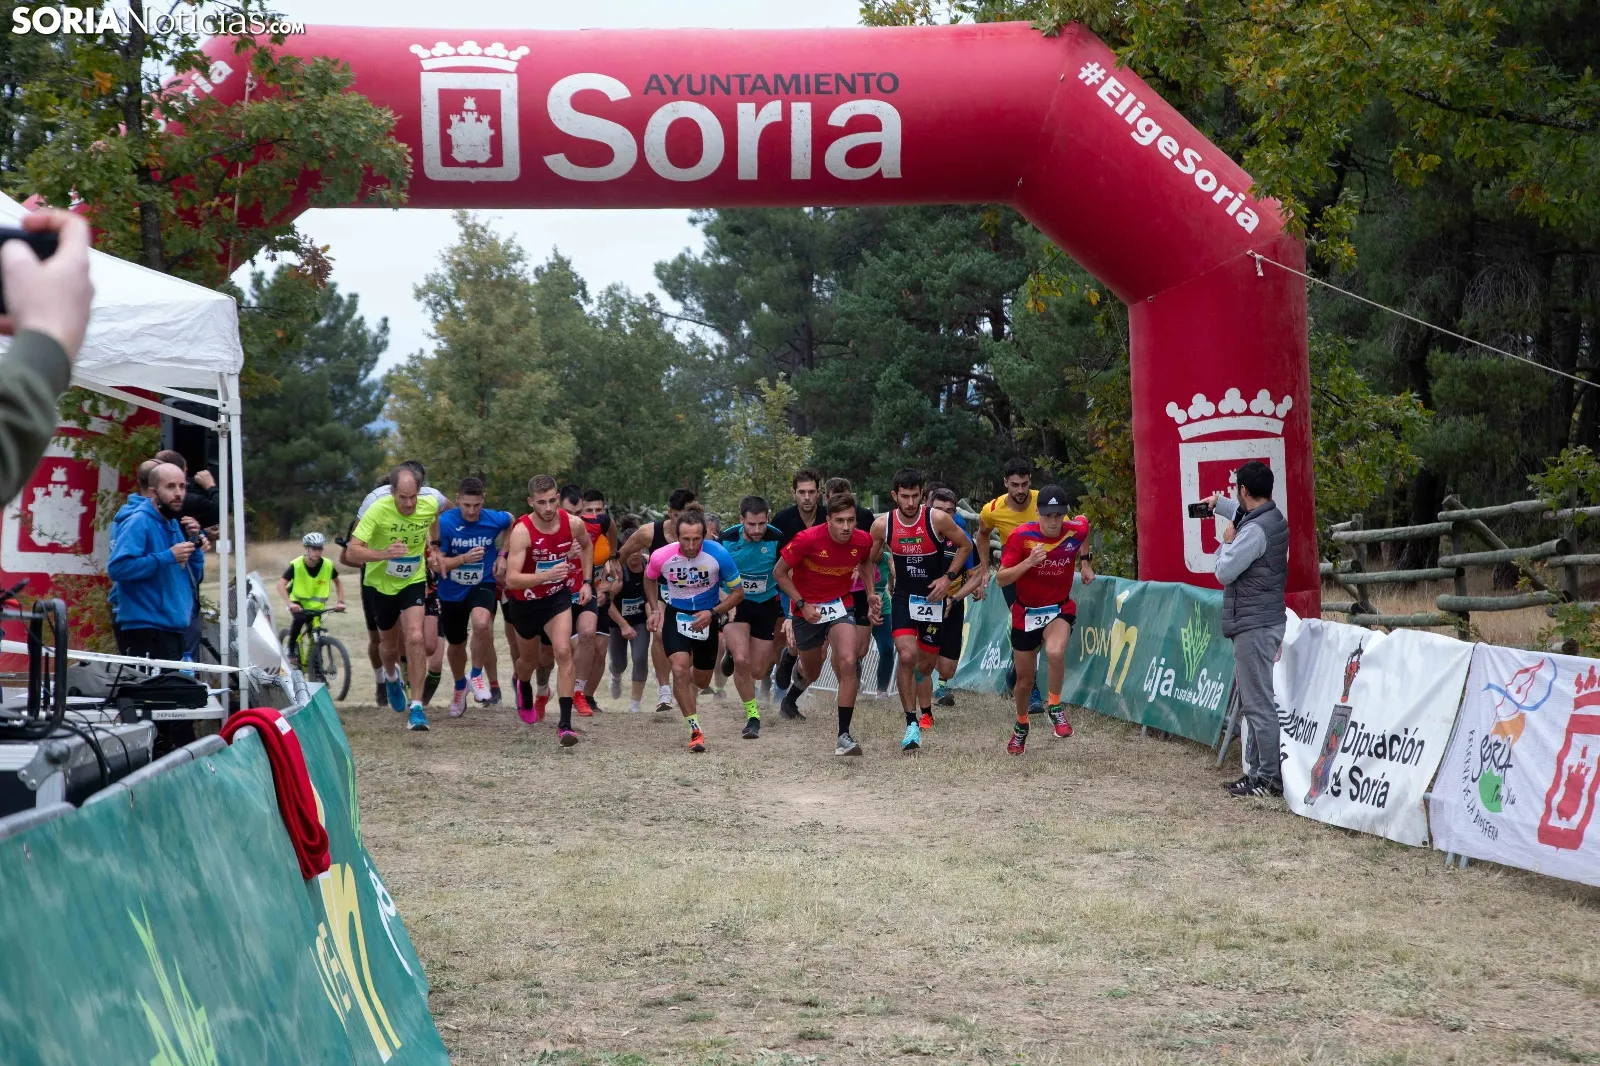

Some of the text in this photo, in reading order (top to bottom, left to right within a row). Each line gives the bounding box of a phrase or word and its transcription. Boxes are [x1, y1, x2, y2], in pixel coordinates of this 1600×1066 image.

[643, 72, 900, 96] AYUNTAMIENTO
[542, 72, 903, 182] Soria
[1078, 61, 1260, 234] #EligeSoria
[451, 537, 492, 547] MetLife
[1034, 557, 1071, 569] SPAÑA
[396, 565, 412, 573] 8A
[456, 572, 478, 580] 15A
[743, 581, 758, 589] 5A
[820, 606, 837, 616] 4A
[917, 606, 933, 616] 2A
[1348, 765, 1390, 808] Soria
